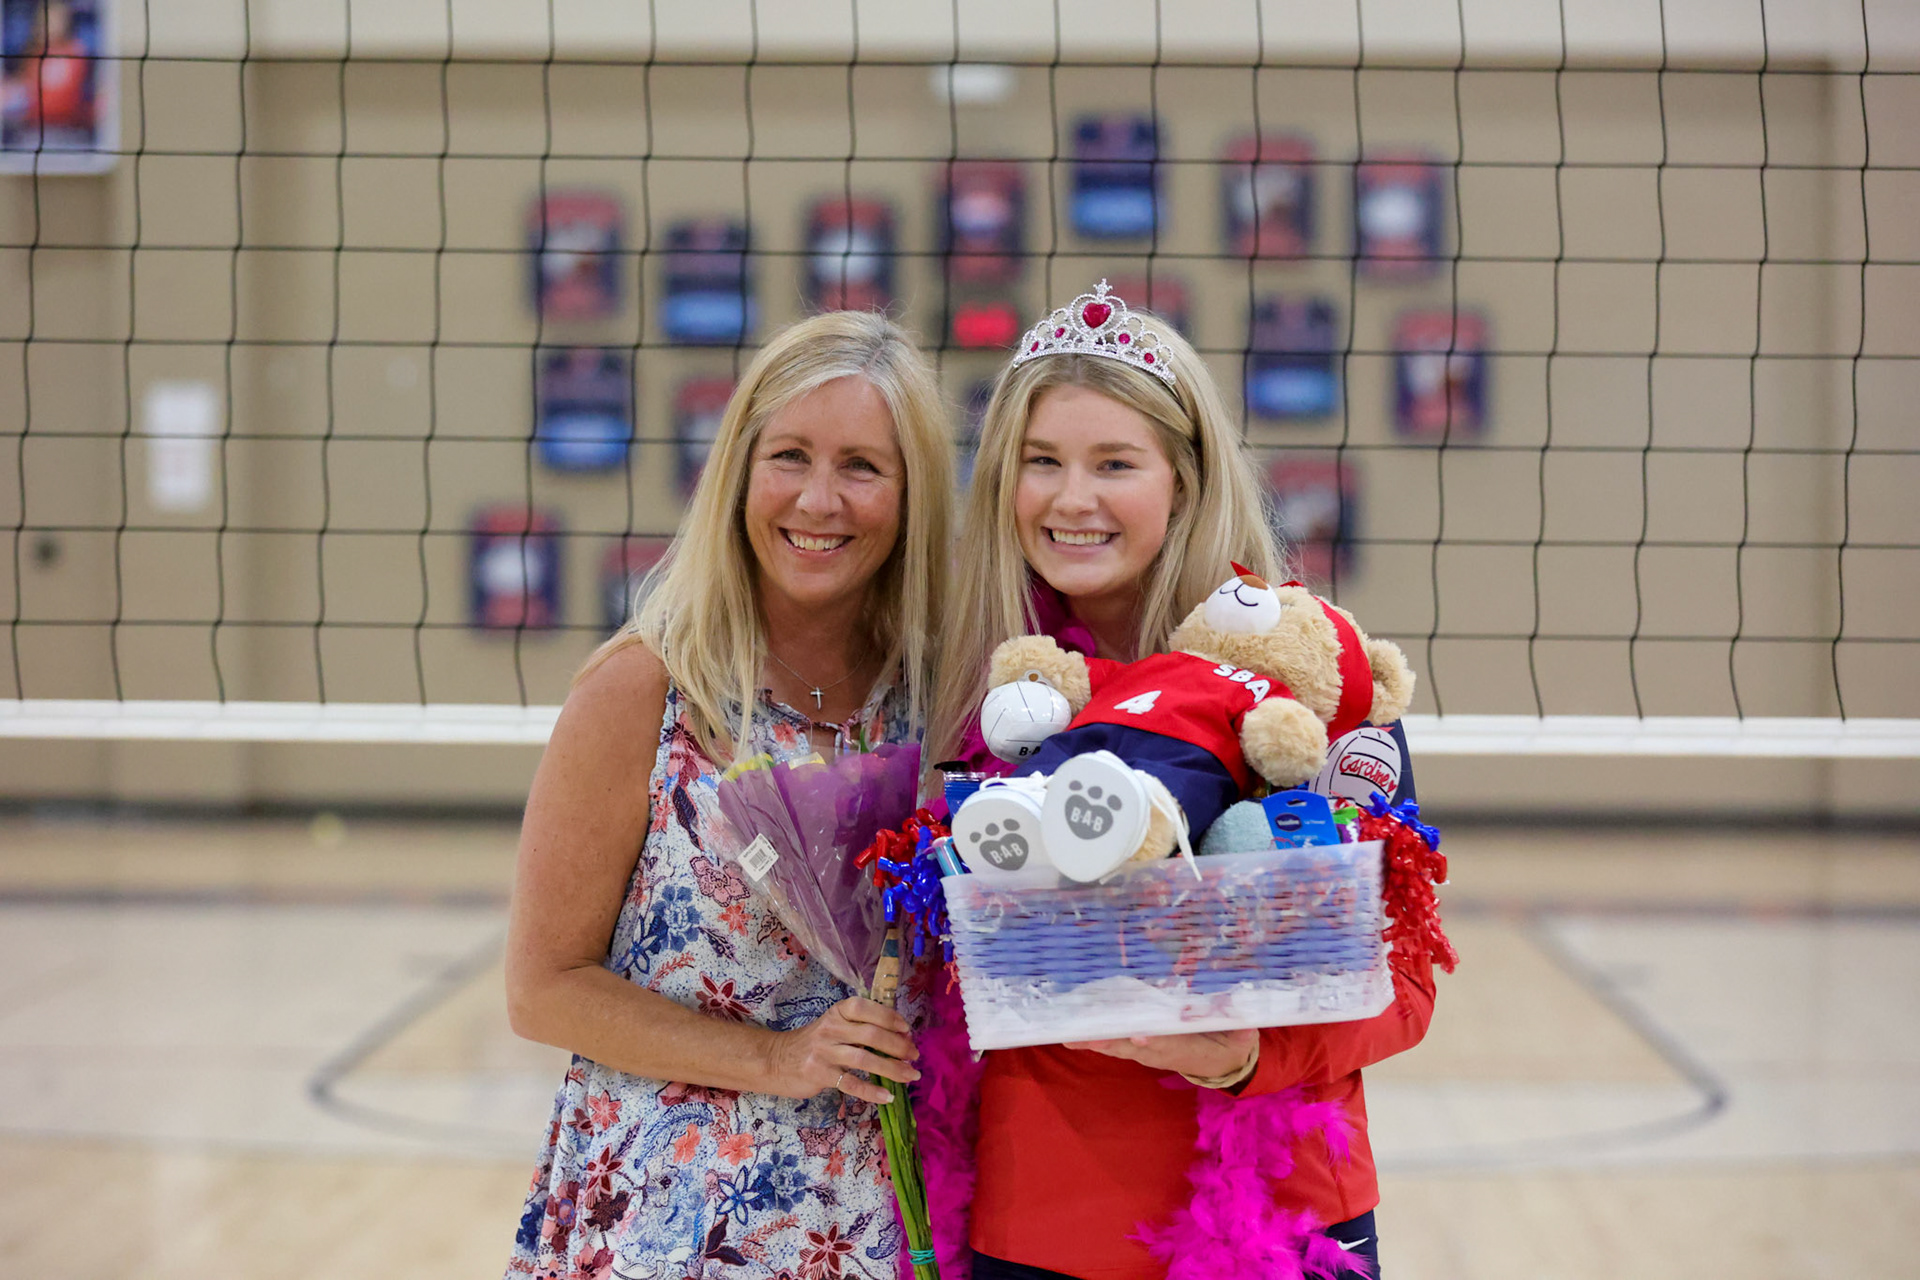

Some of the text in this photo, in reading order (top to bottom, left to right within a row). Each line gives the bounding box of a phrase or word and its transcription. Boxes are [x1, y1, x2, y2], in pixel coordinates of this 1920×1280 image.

[1213, 664, 1271, 703] SBA
[1113, 690, 1162, 715] 4
[1339, 755, 1390, 787] Caroline
